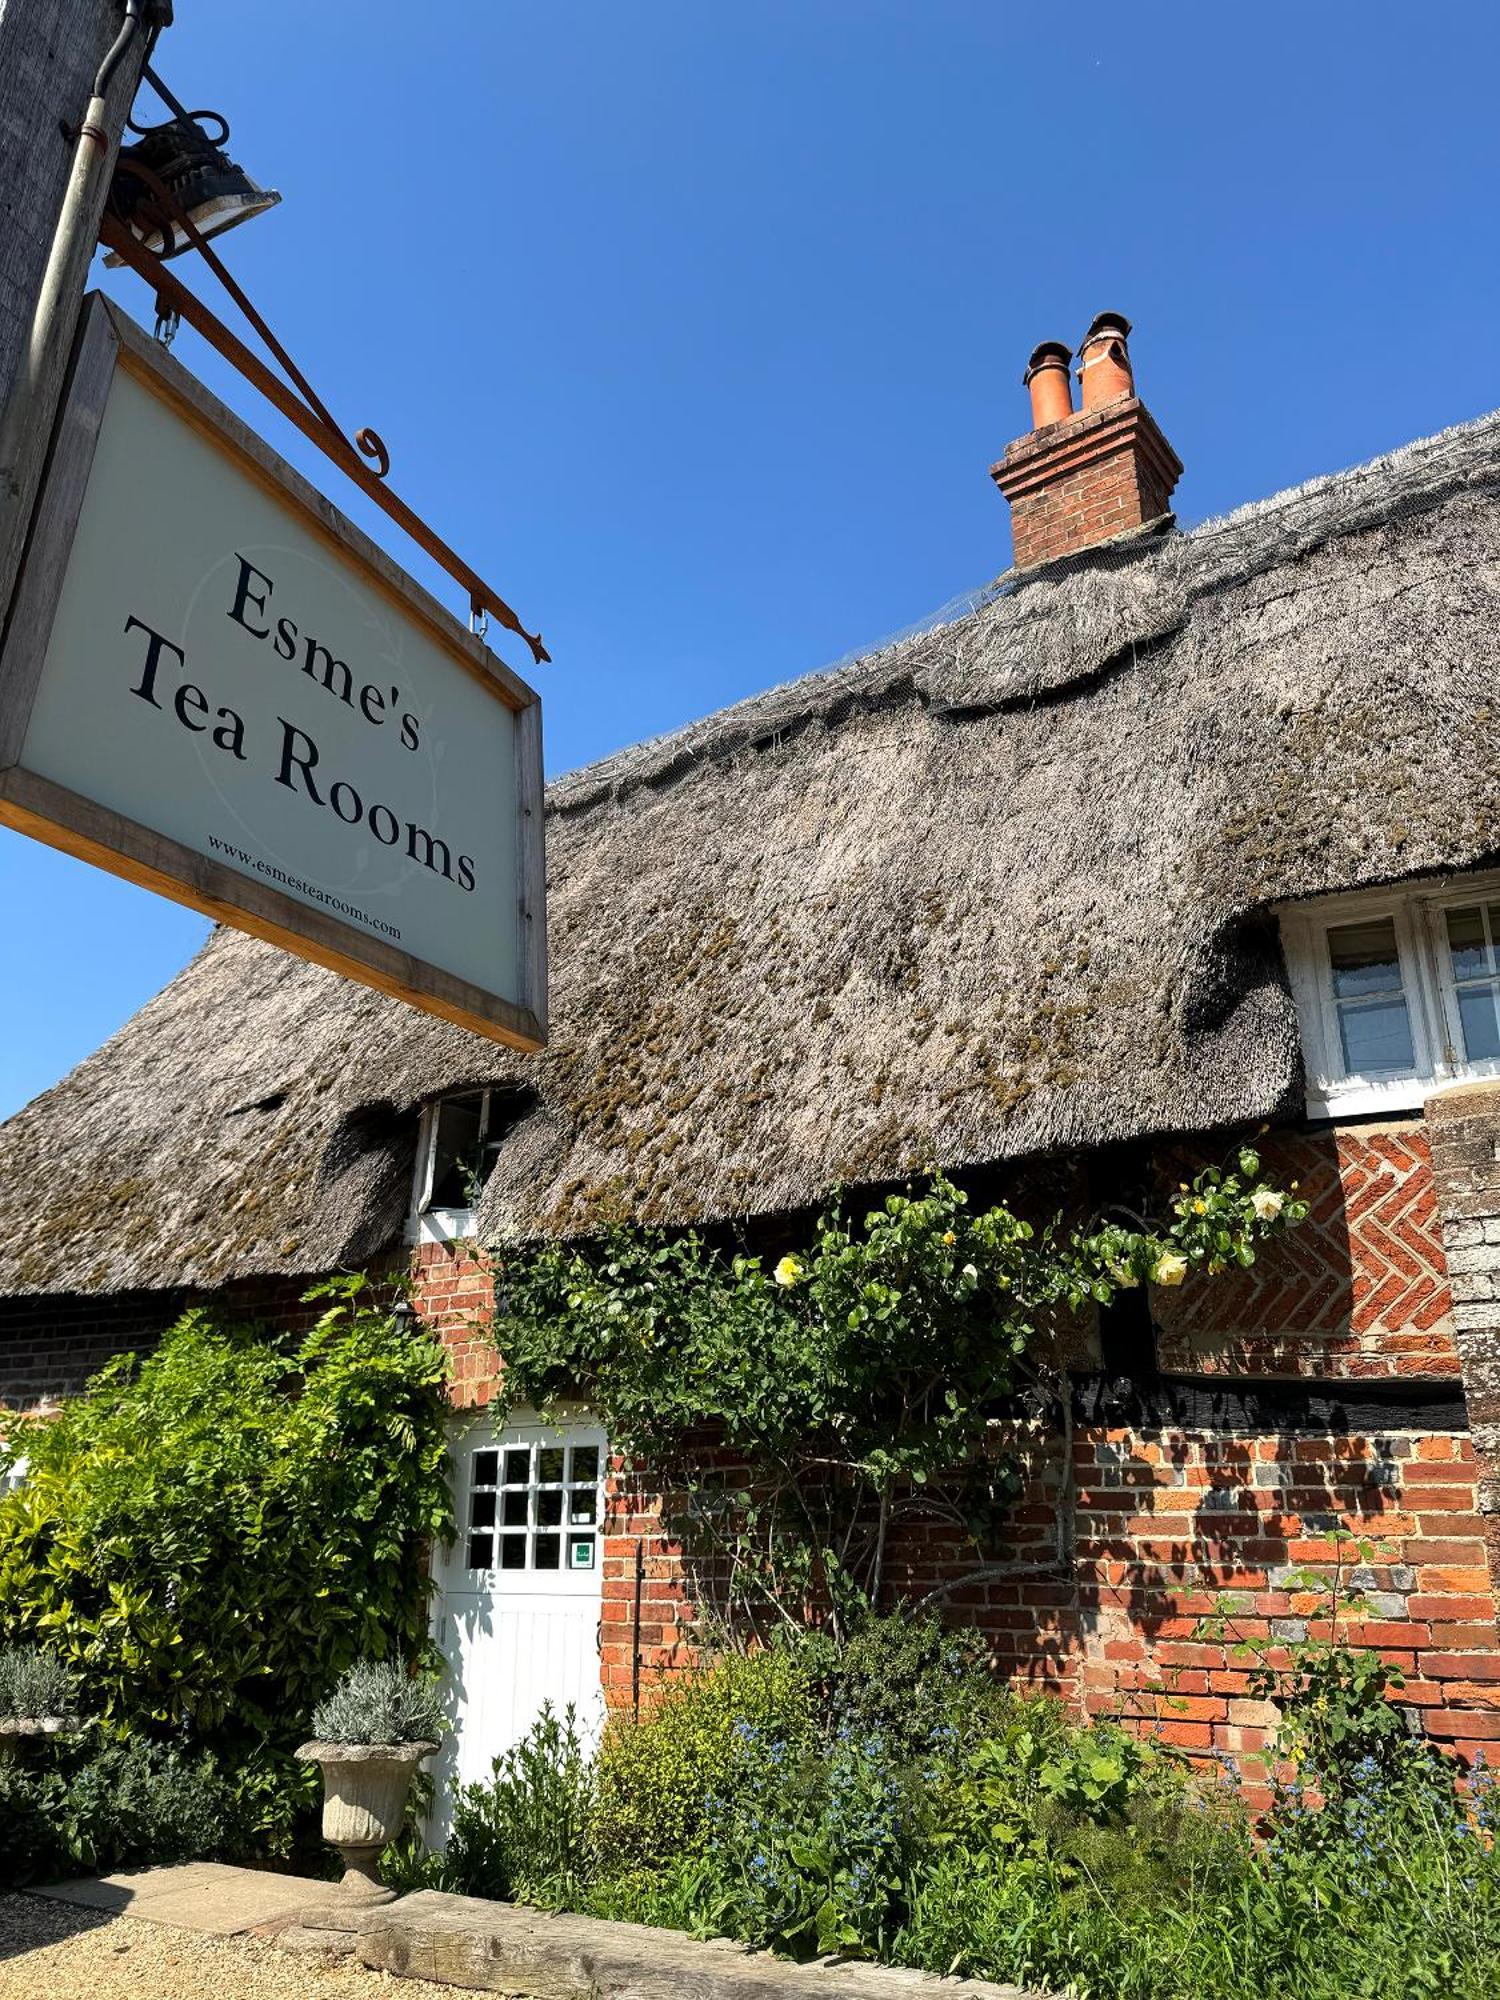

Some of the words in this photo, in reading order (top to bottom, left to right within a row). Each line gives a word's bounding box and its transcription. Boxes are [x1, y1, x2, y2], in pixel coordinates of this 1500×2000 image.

[226, 551, 420, 752] Esme's
[123, 614, 248, 761] Tea
[274, 716, 476, 892] Rooms
[208, 834, 401, 940] www.esmestearooms.com
